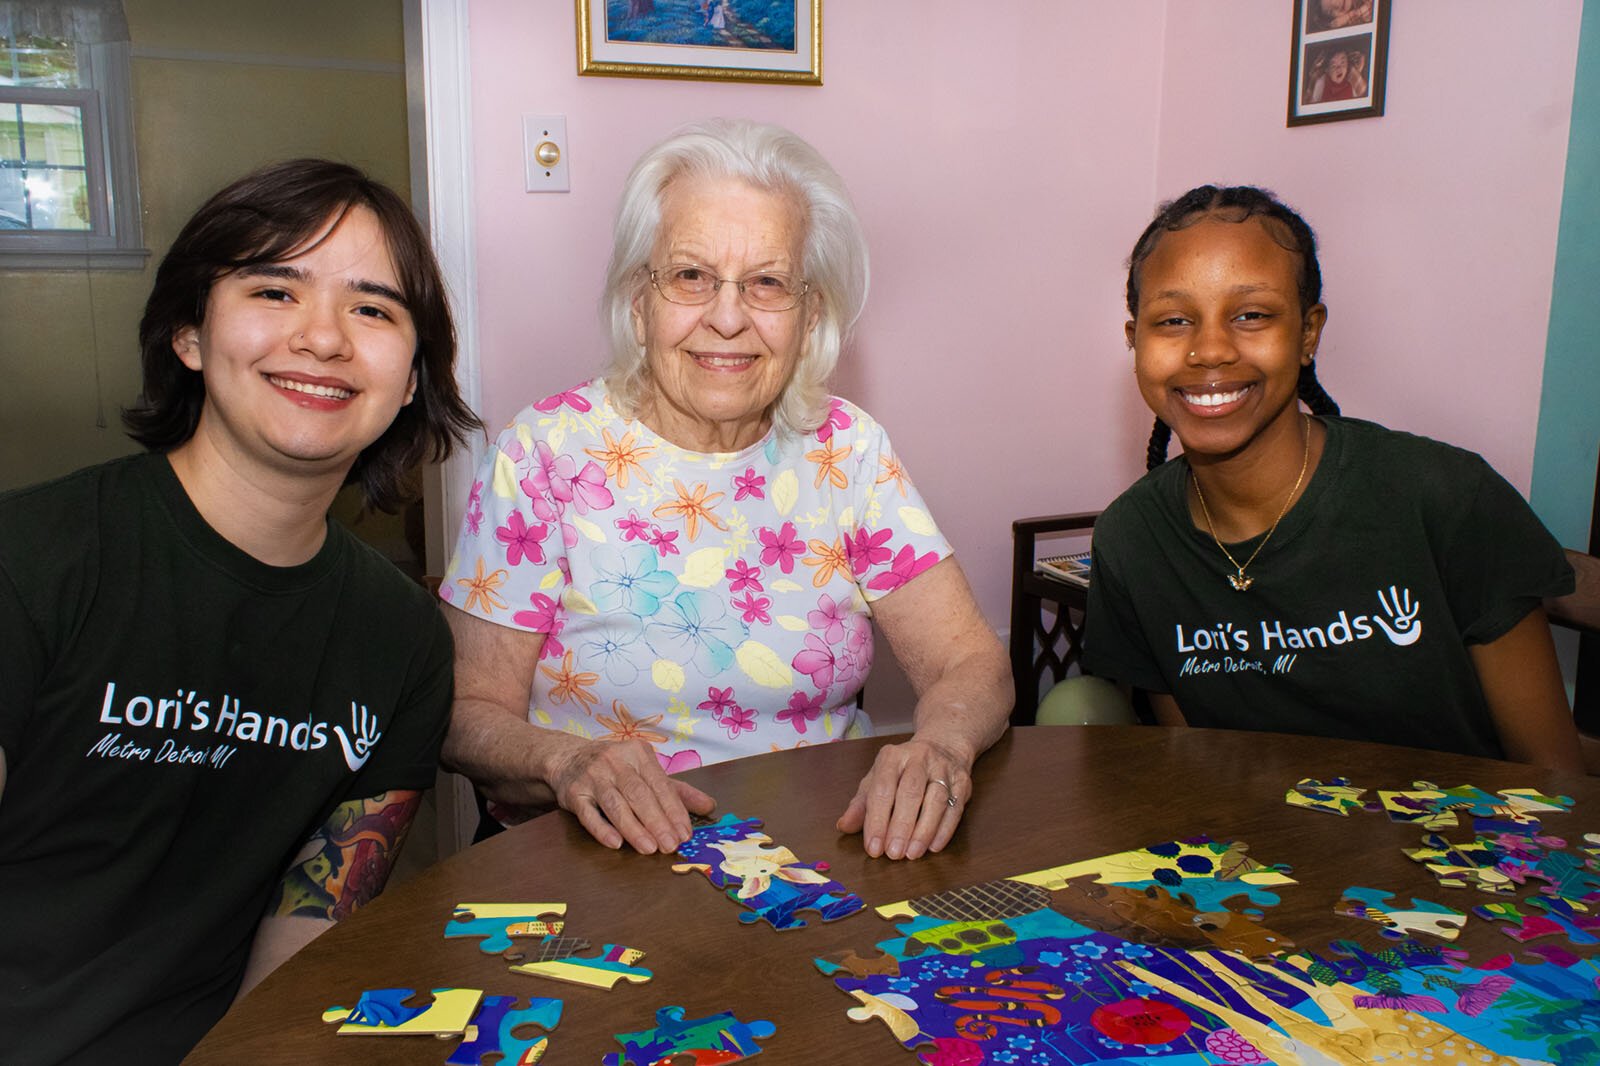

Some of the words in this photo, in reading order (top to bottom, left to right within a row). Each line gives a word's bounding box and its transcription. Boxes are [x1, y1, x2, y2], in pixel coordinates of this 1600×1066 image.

[1176, 623, 1250, 653] Lori's
[1260, 610, 1373, 651] Hands
[1179, 656, 1221, 678] Metro
[1272, 654, 1297, 675] MI
[100, 682, 209, 731] Lori's
[214, 694, 328, 751] Hands
[86, 732, 151, 761] Metro
[209, 744, 238, 769] MI
